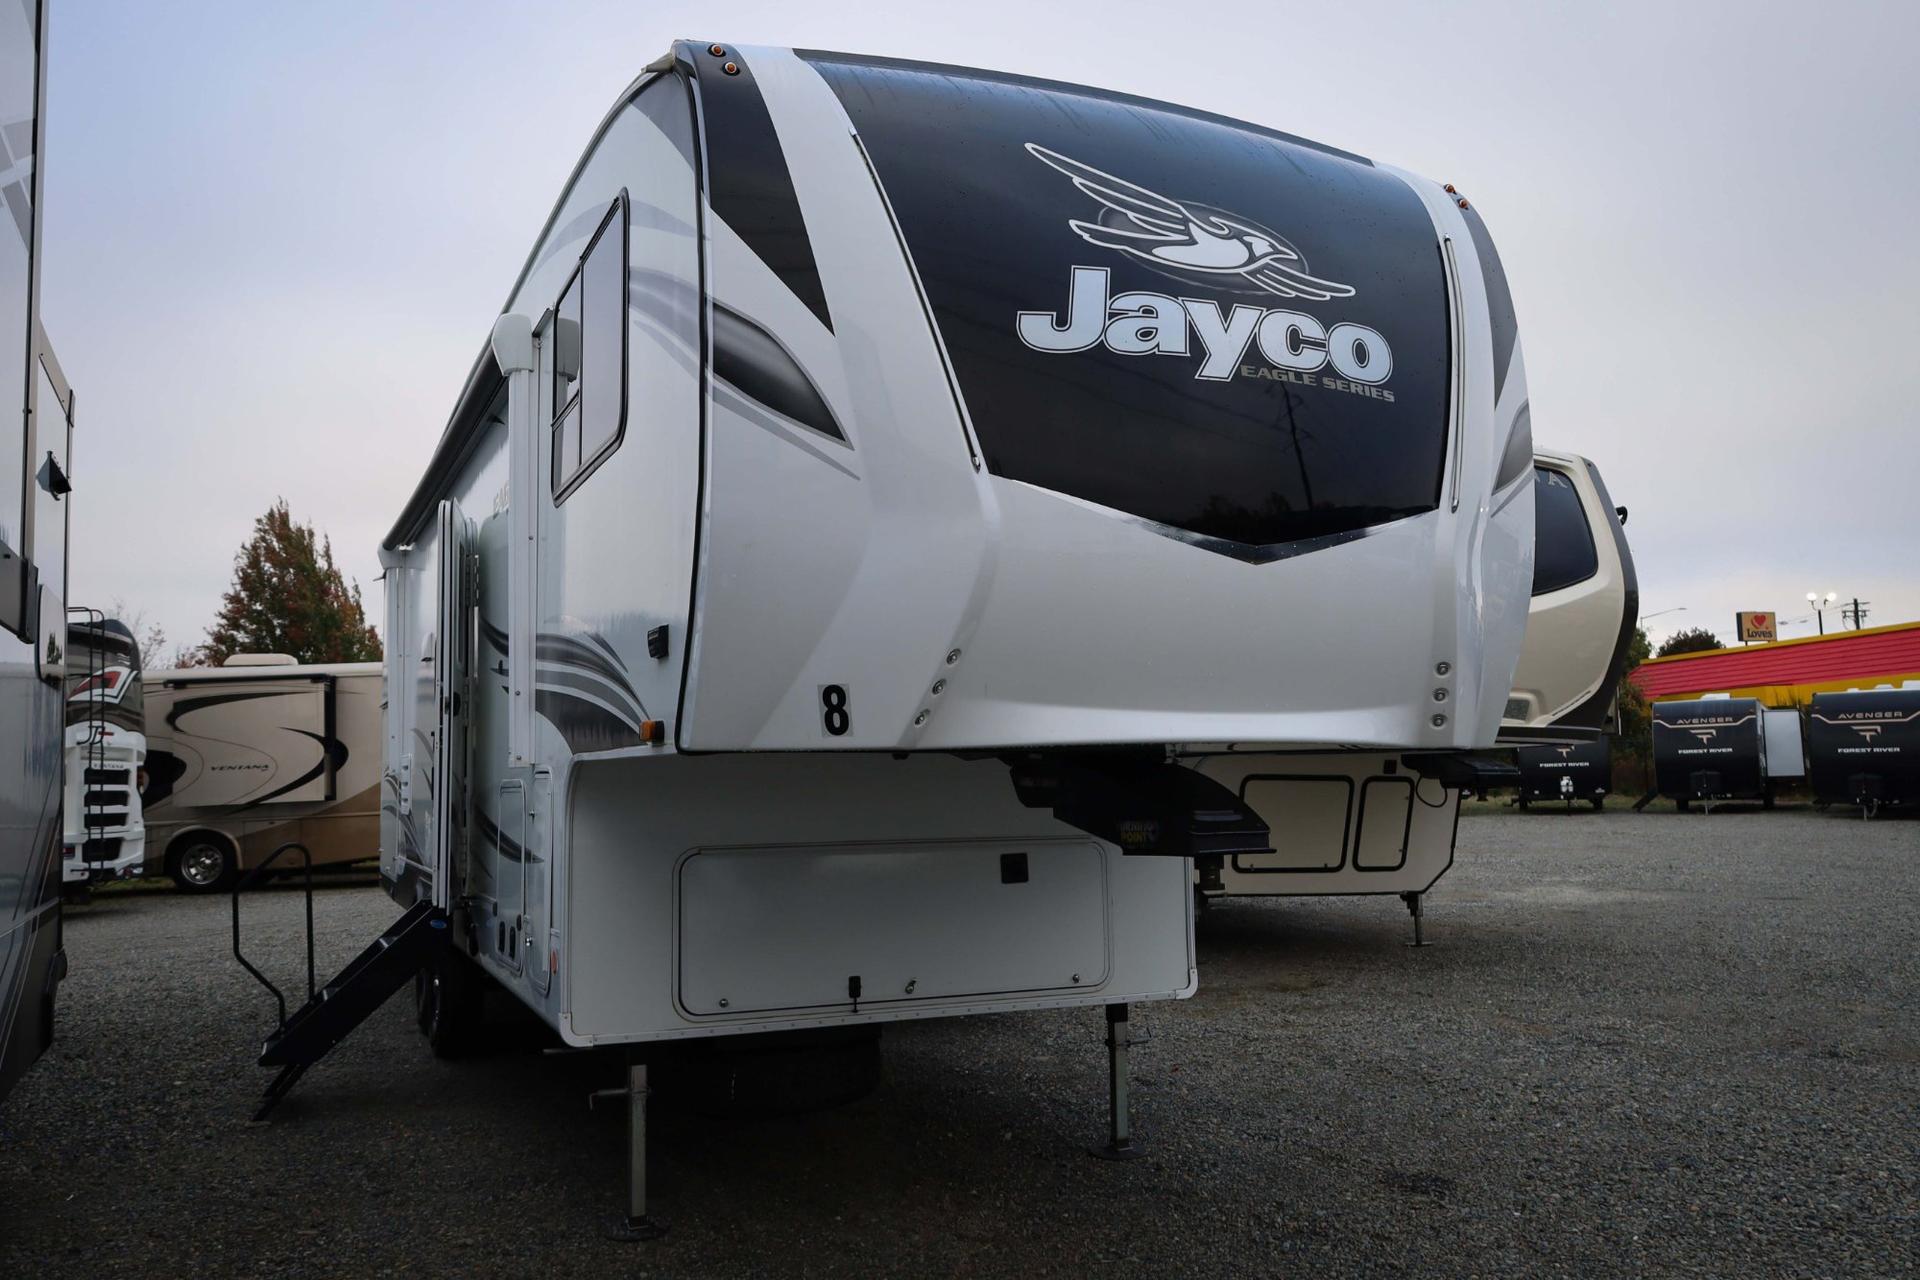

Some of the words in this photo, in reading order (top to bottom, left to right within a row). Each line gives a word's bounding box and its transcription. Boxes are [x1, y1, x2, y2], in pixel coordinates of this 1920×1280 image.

[1016, 265, 1393, 384] Jayco
[1240, 364, 1317, 387] EAGLE
[1322, 376, 1395, 403] SERIES
[822, 684, 849, 736] 8
[1676, 717, 1734, 725] AVENGER
[1838, 711, 1903, 719] AVENGER
